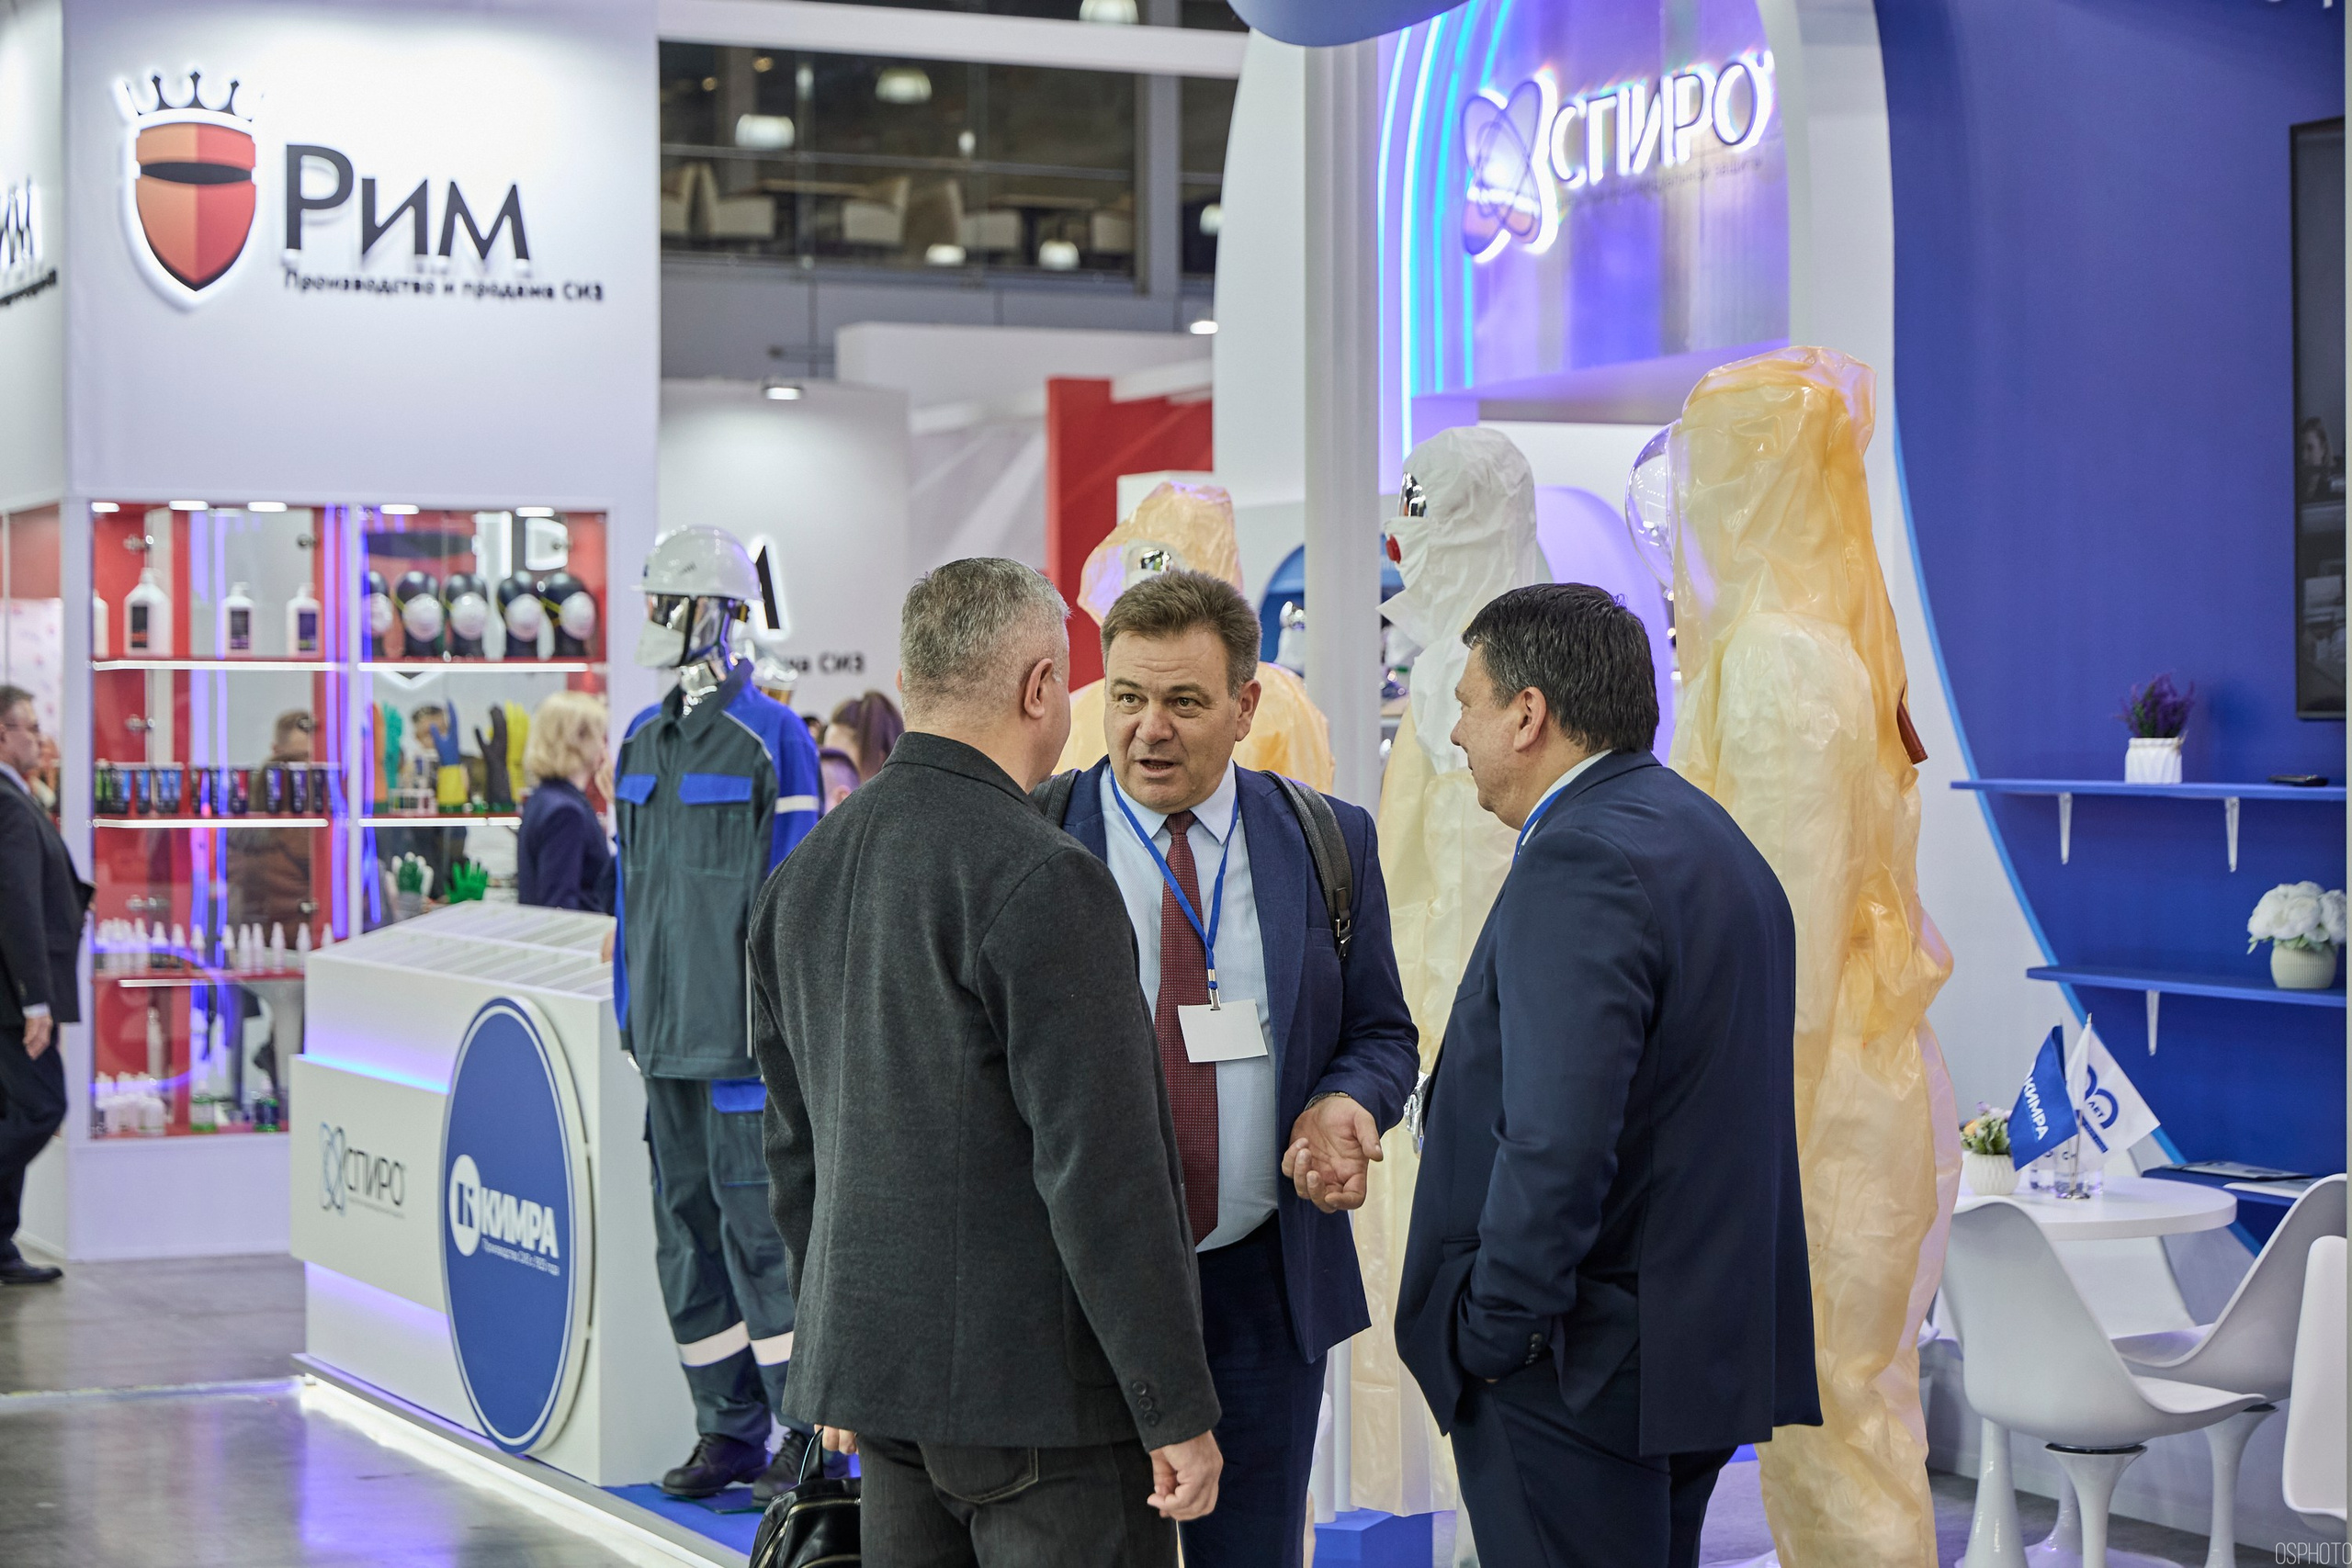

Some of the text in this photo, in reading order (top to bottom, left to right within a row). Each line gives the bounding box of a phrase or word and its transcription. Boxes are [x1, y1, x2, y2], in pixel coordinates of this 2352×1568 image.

[1549, 61, 1770, 187] СПИРО
[285, 268, 603, 301] Производство и продажа СИЗ
[819, 653, 865, 675] СИЗ
[2023, 1077, 2049, 1141] КИМРА
[343, 1146, 404, 1207] СПИРО
[480, 1186, 560, 1259] КИМРА
